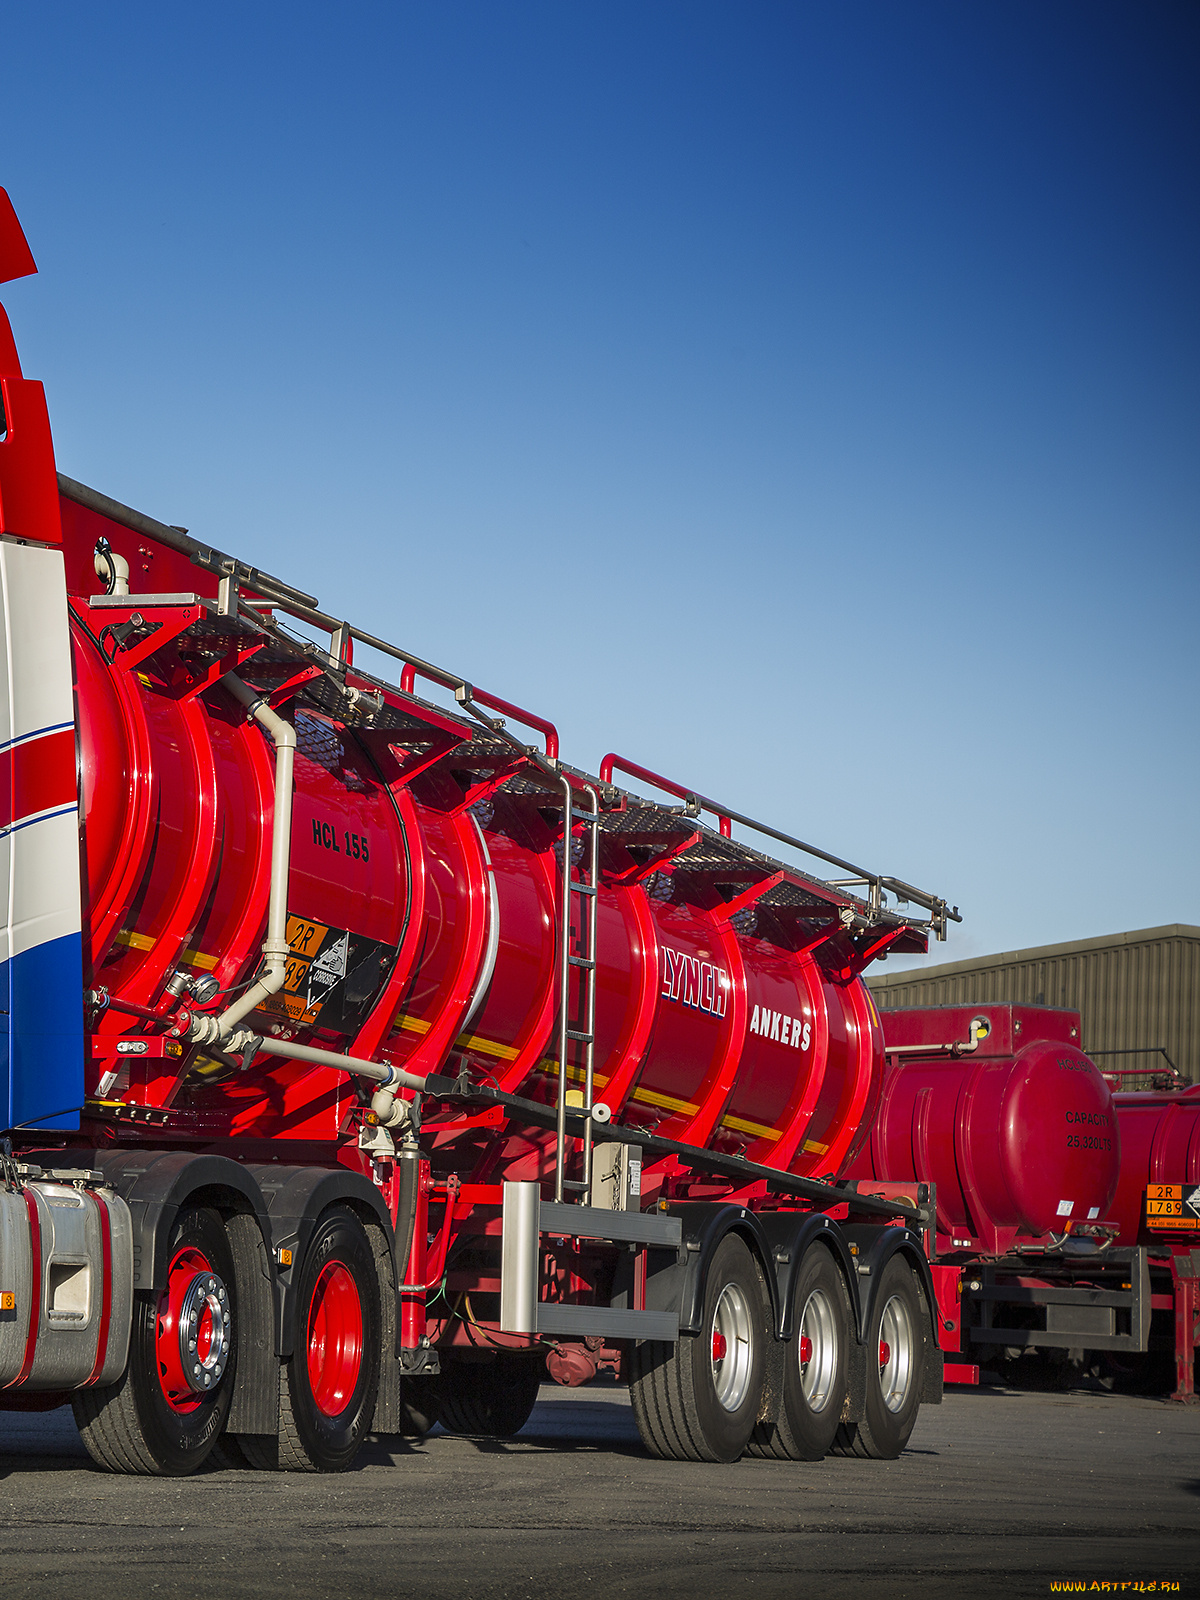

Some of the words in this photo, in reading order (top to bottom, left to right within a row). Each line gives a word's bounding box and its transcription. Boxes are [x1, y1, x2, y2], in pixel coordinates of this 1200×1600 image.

[311, 818, 340, 853] HCL
[344, 831, 369, 863] 155
[289, 923, 315, 952] 2R
[285, 962, 307, 988] 89
[661, 945, 728, 1020] LYNCH
[750, 1004, 812, 1052] ANKERS
[1065, 1111, 1109, 1127] CAPACITY
[1066, 1134, 1112, 1152] 25,320LTS
[1157, 1186, 1173, 1198] 2R
[1149, 1201, 1182, 1214] 1789
